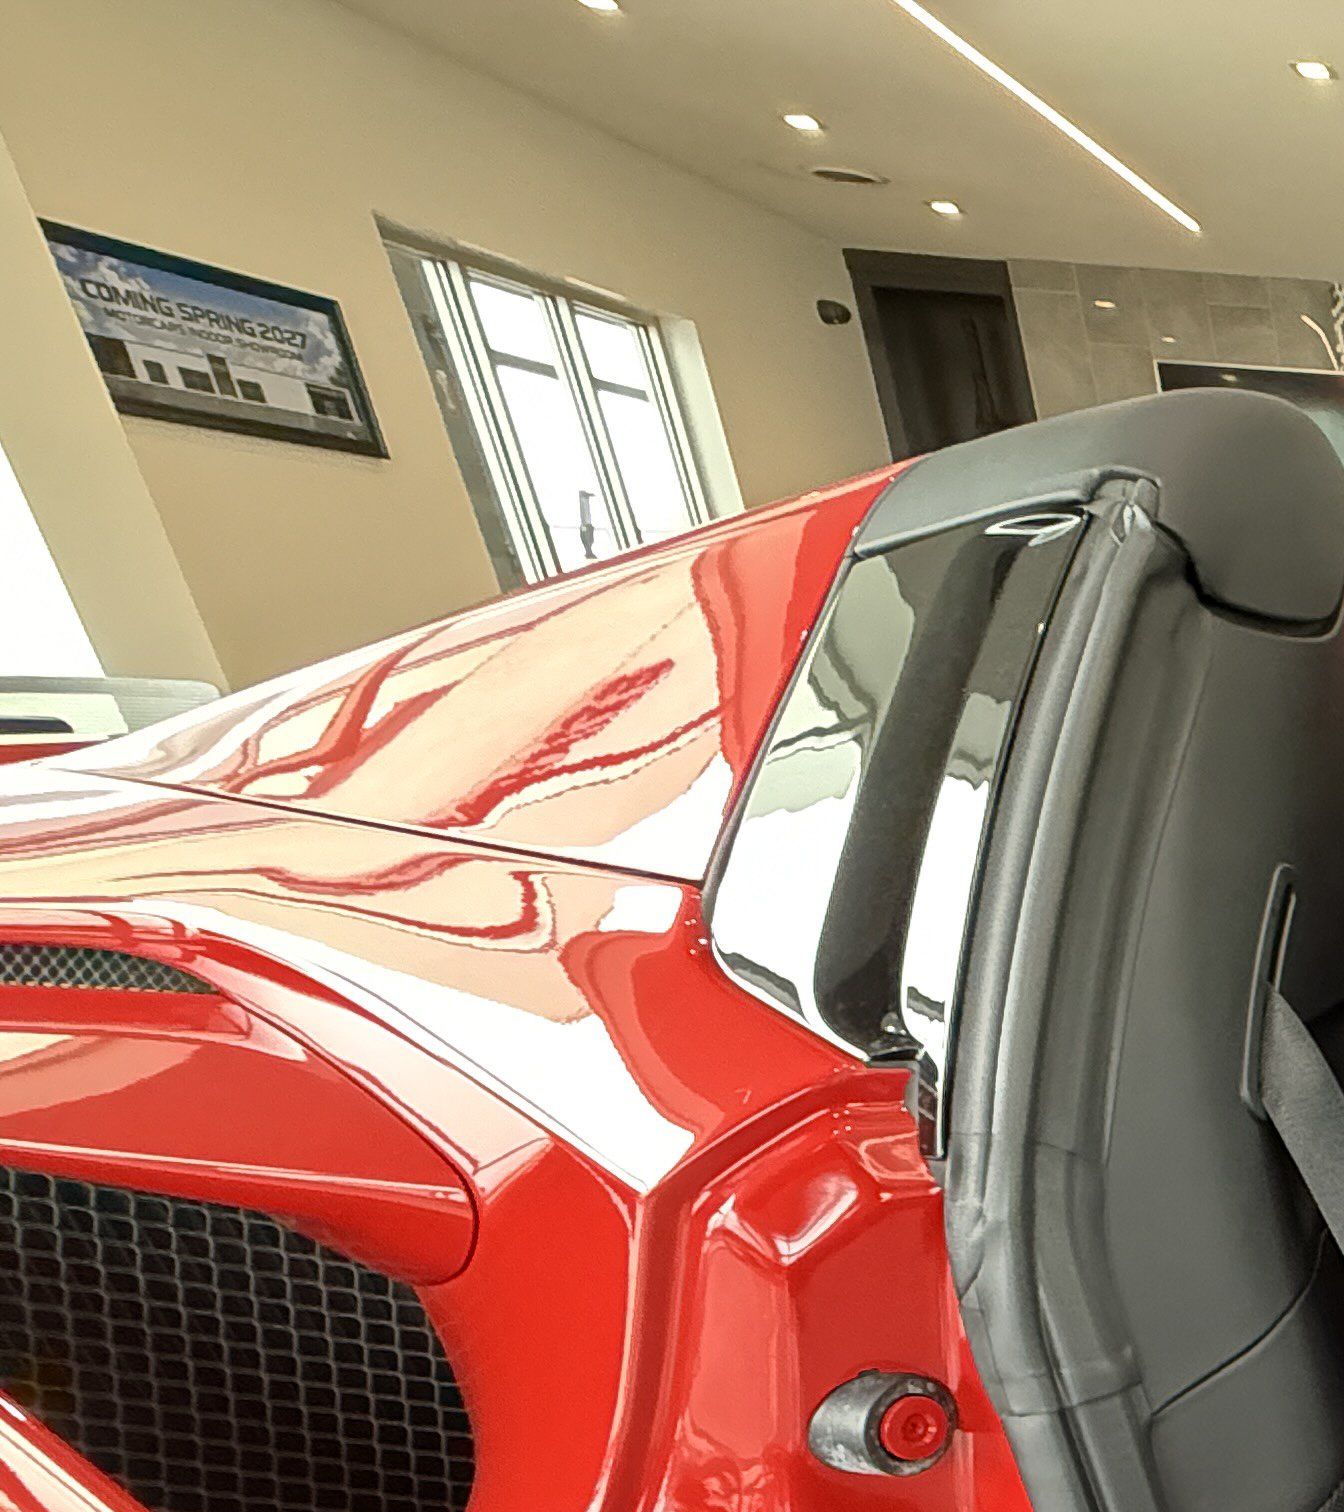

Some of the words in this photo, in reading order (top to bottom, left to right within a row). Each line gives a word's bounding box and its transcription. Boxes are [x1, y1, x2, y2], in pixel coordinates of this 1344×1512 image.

[80, 278, 173, 318] COMING
[178, 302, 256, 337] SPRING
[256, 321, 307, 349] 2027
